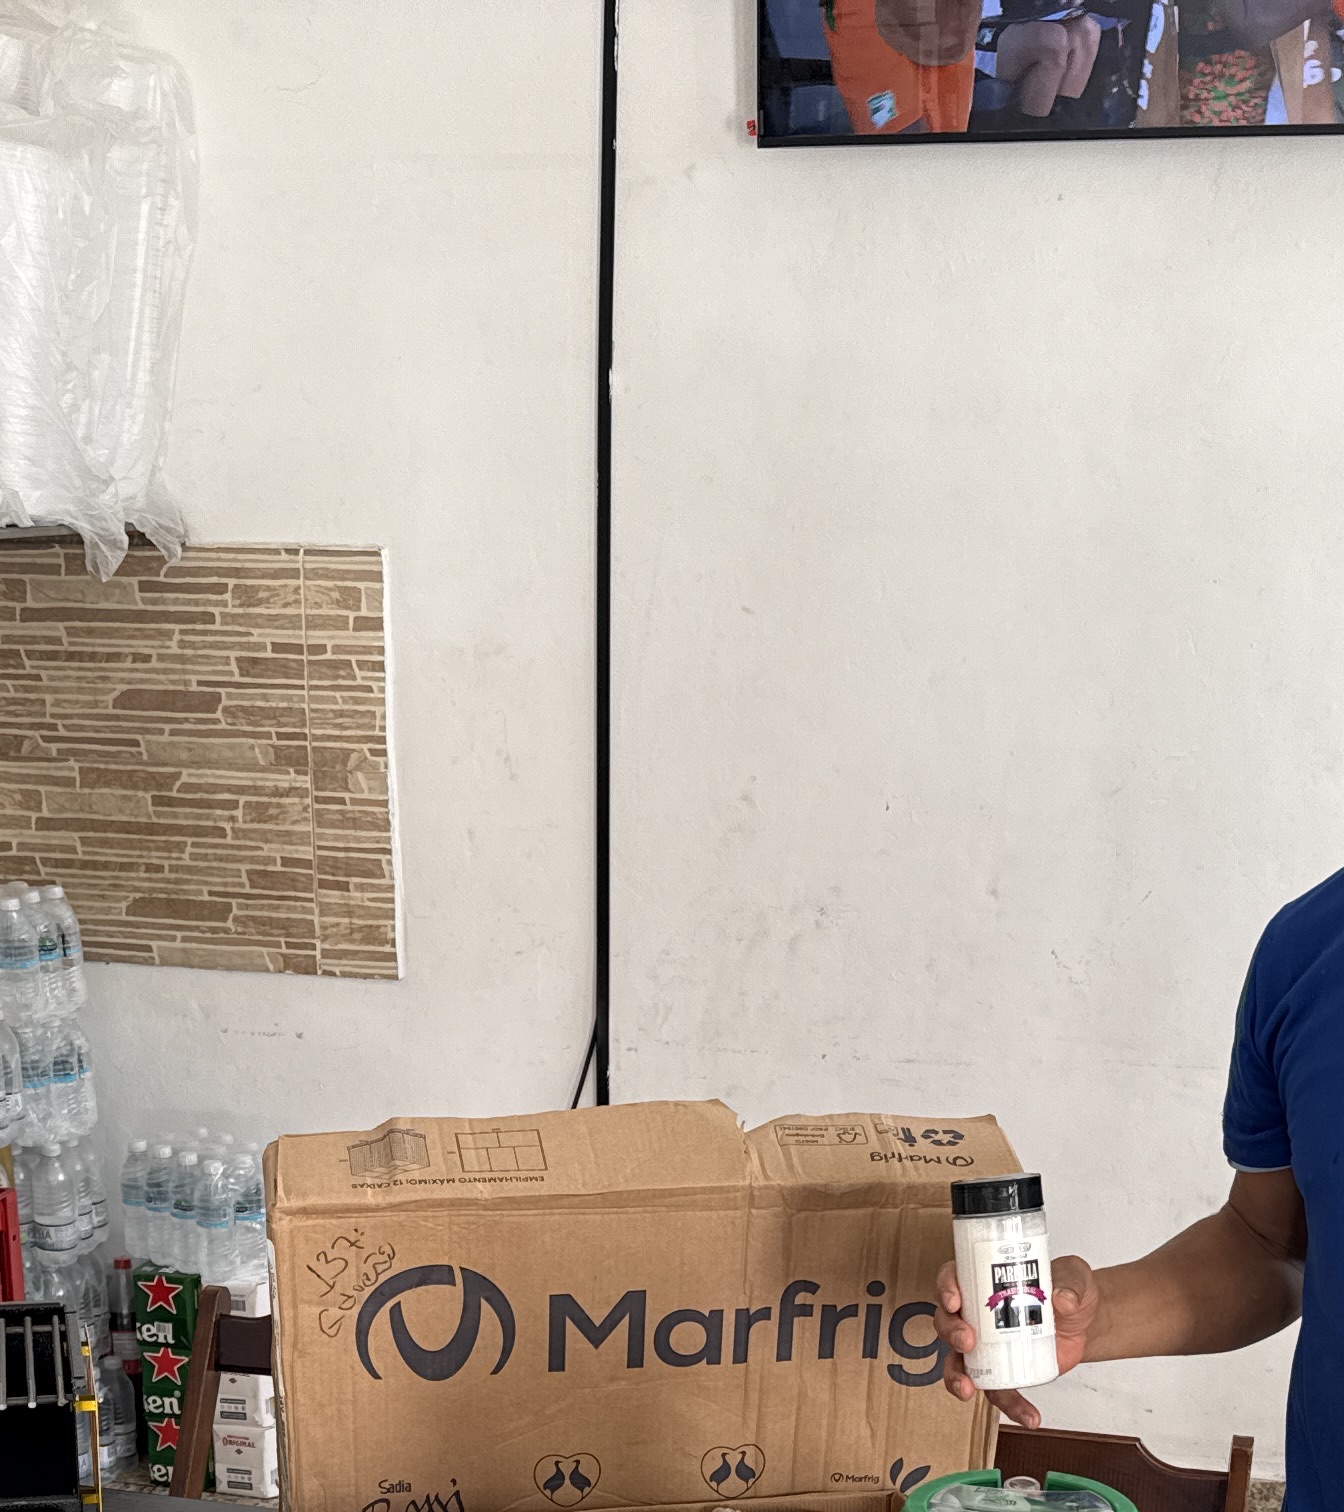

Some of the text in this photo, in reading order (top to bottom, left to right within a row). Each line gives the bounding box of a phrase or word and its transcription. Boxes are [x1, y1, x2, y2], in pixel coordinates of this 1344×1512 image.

[869, 1151, 942, 1166] Marfrig
[392, 1179, 404, 1187] 12
[458, 1175, 545, 1184] EMPILHAMENTO
[350, 1182, 391, 1190] CAIXAS
[547, 1279, 949, 1388] Marfrig
[221, 1436, 257, 1449] ORIGINAL
[844, 1473, 880, 1485] Marfrig
[378, 1478, 412, 1495] Sadia
